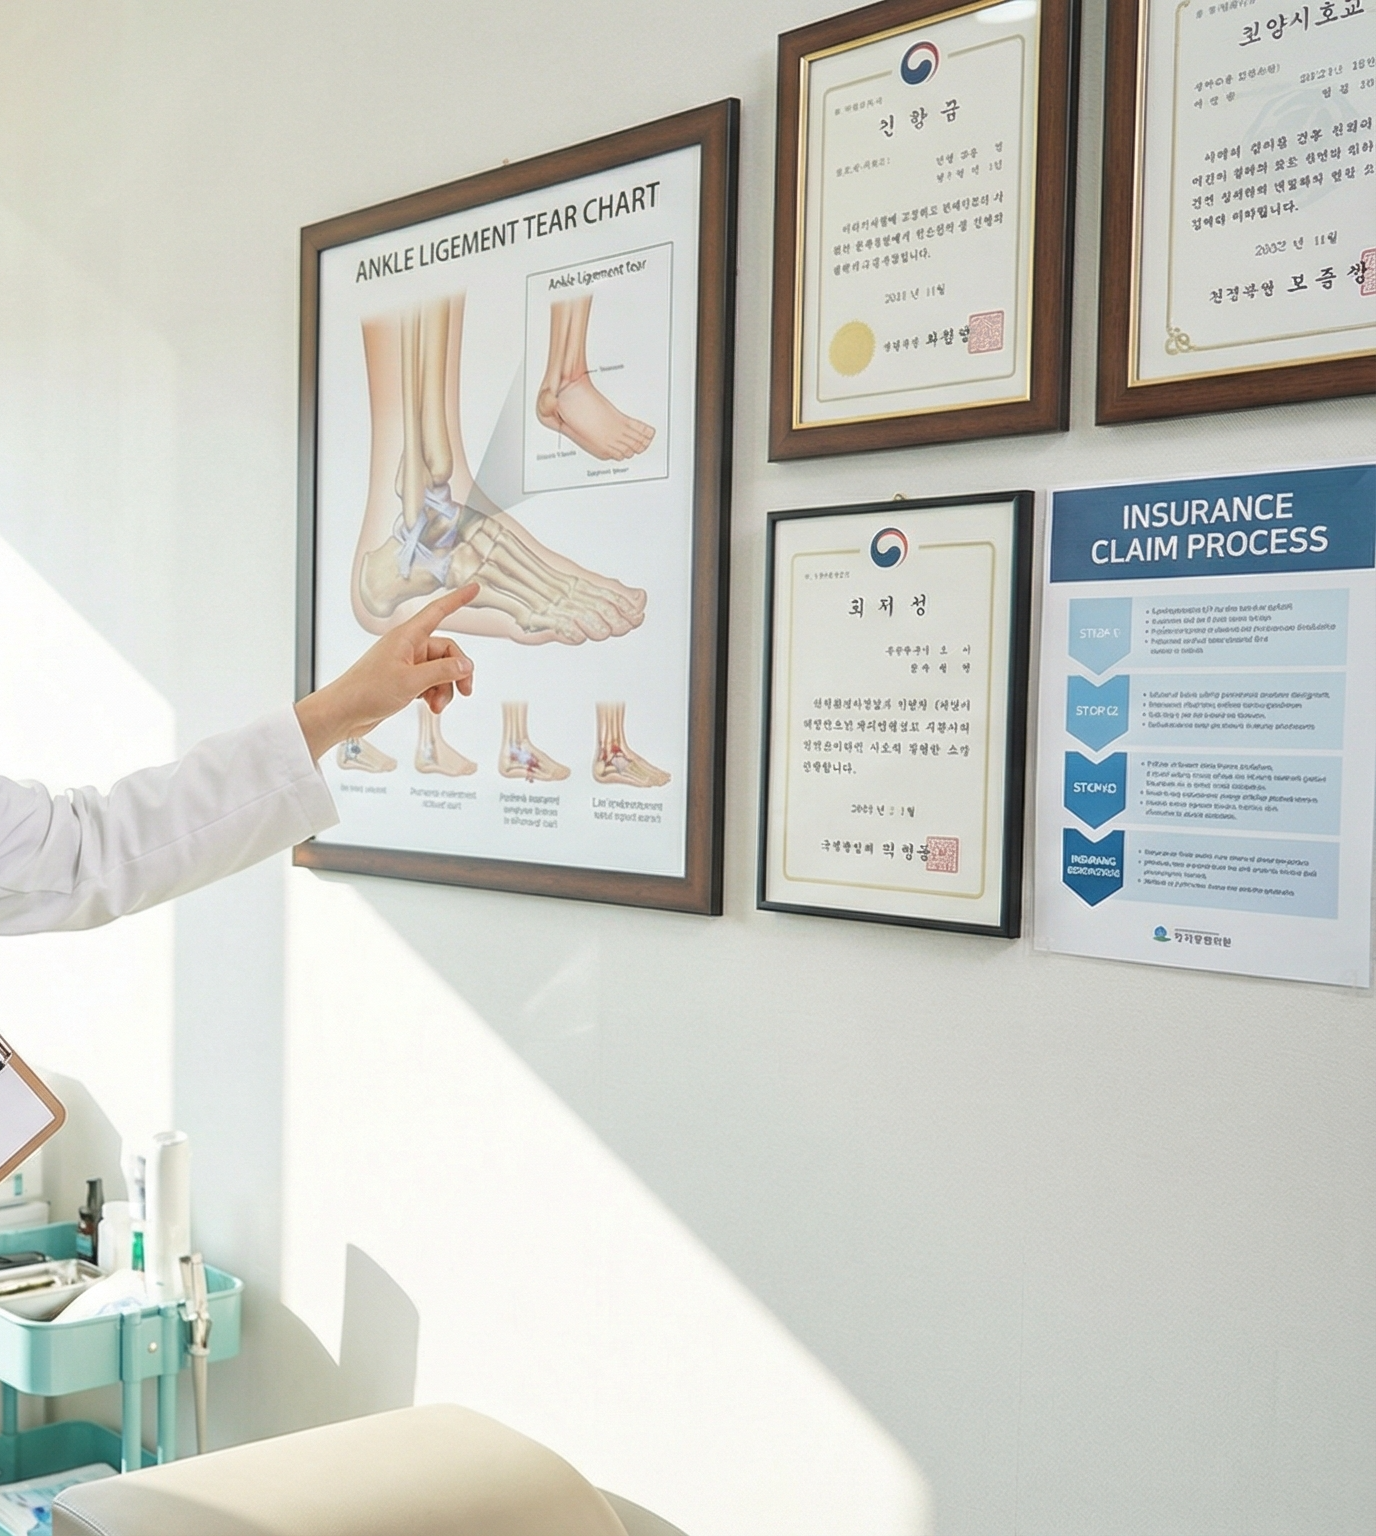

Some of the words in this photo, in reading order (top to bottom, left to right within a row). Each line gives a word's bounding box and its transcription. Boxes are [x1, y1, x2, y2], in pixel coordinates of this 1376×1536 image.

[355, 246, 415, 284] ANKLE
[419, 219, 520, 268] LIGEMENT
[523, 204, 577, 240] TEAR
[582, 181, 661, 225] CHART
[1123, 492, 1294, 530] INSURANCE
[1090, 534, 1178, 565] CLAIM
[1186, 525, 1329, 560] PROCESS
